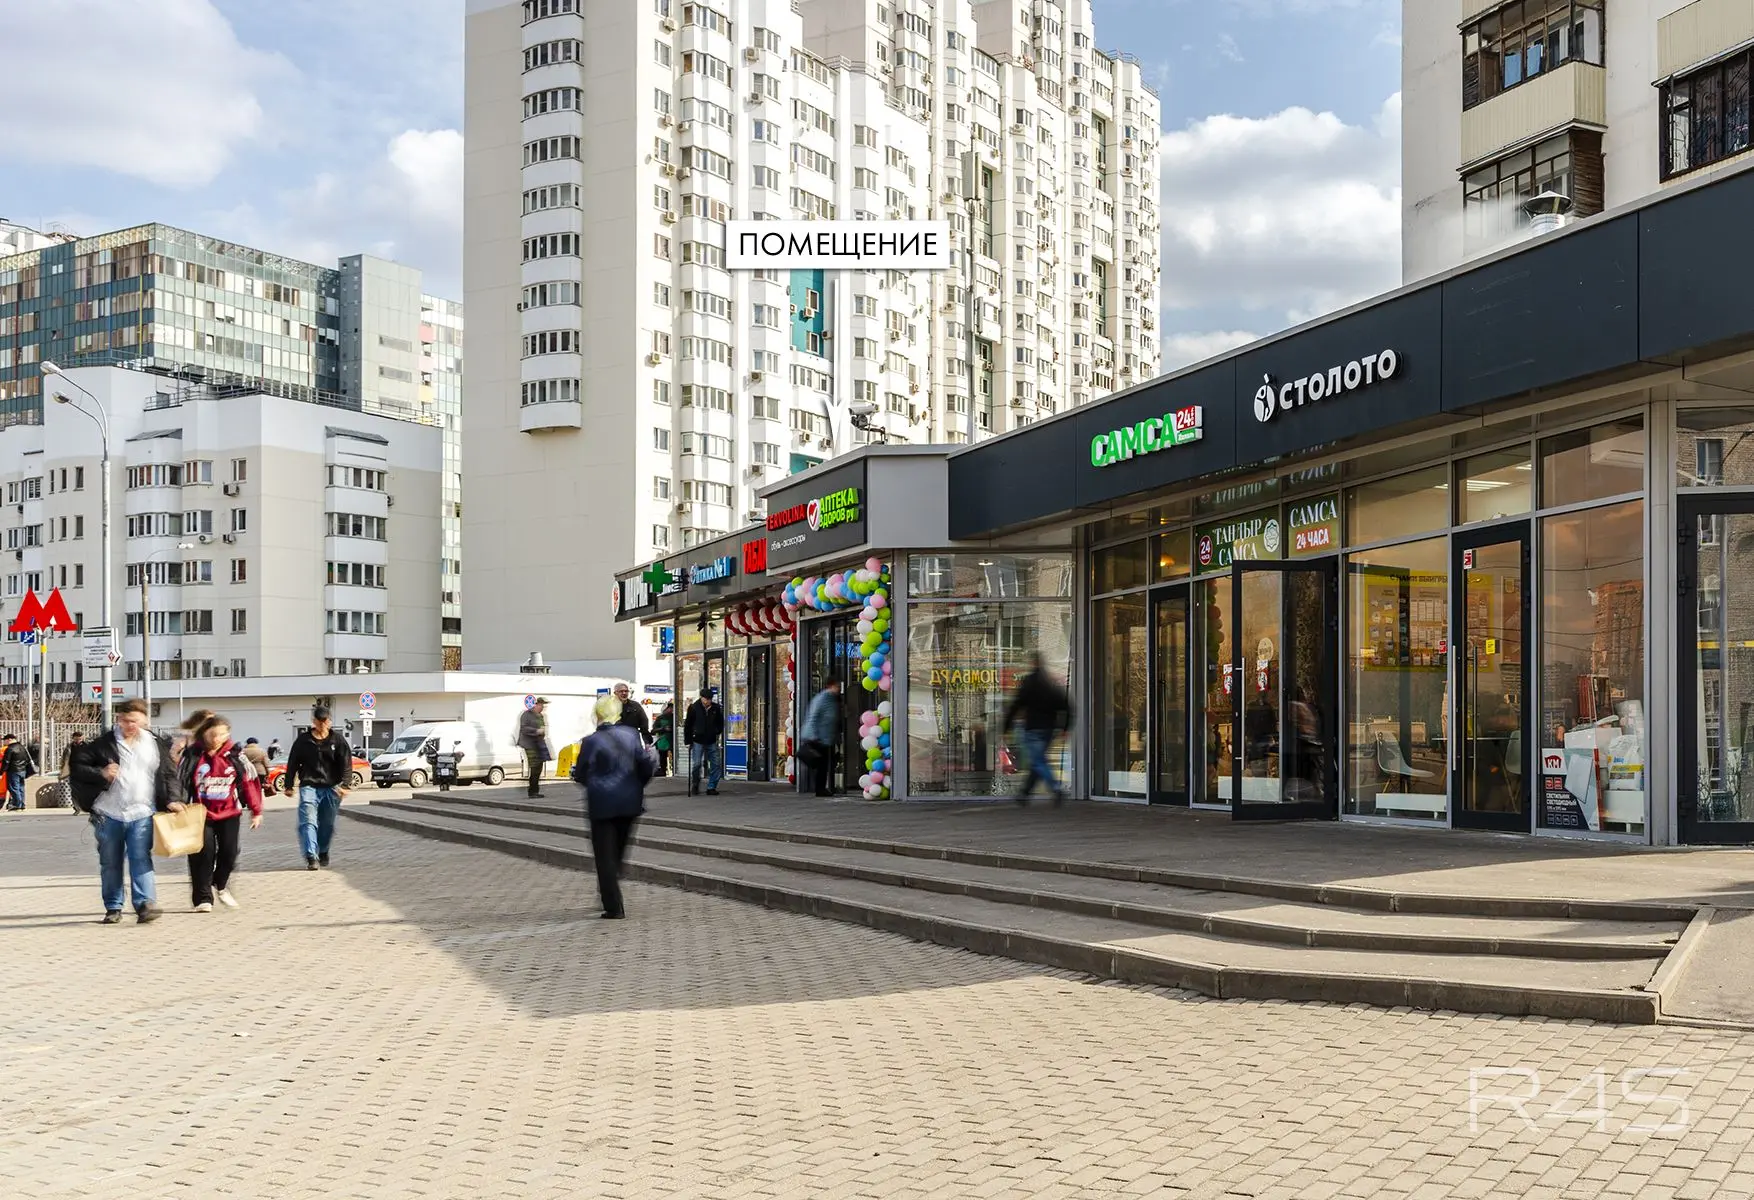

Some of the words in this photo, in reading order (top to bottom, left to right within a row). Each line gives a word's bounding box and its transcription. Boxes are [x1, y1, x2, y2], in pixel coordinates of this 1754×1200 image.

[1279, 349, 1397, 410] СТОЛОТО
[1177, 410, 1191, 430] 24
[1091, 413, 1176, 467] САМСА
[819, 487, 858, 514] АПТЕКА
[1290, 500, 1337, 528] САМСА
[1215, 519, 1262, 545] ТАНДЫР
[1296, 534, 1306, 549] 24
[1307, 528, 1329, 547] ЧАСА
[1200, 540, 1210, 554] 24
[1218, 542, 1258, 566] САМСА
